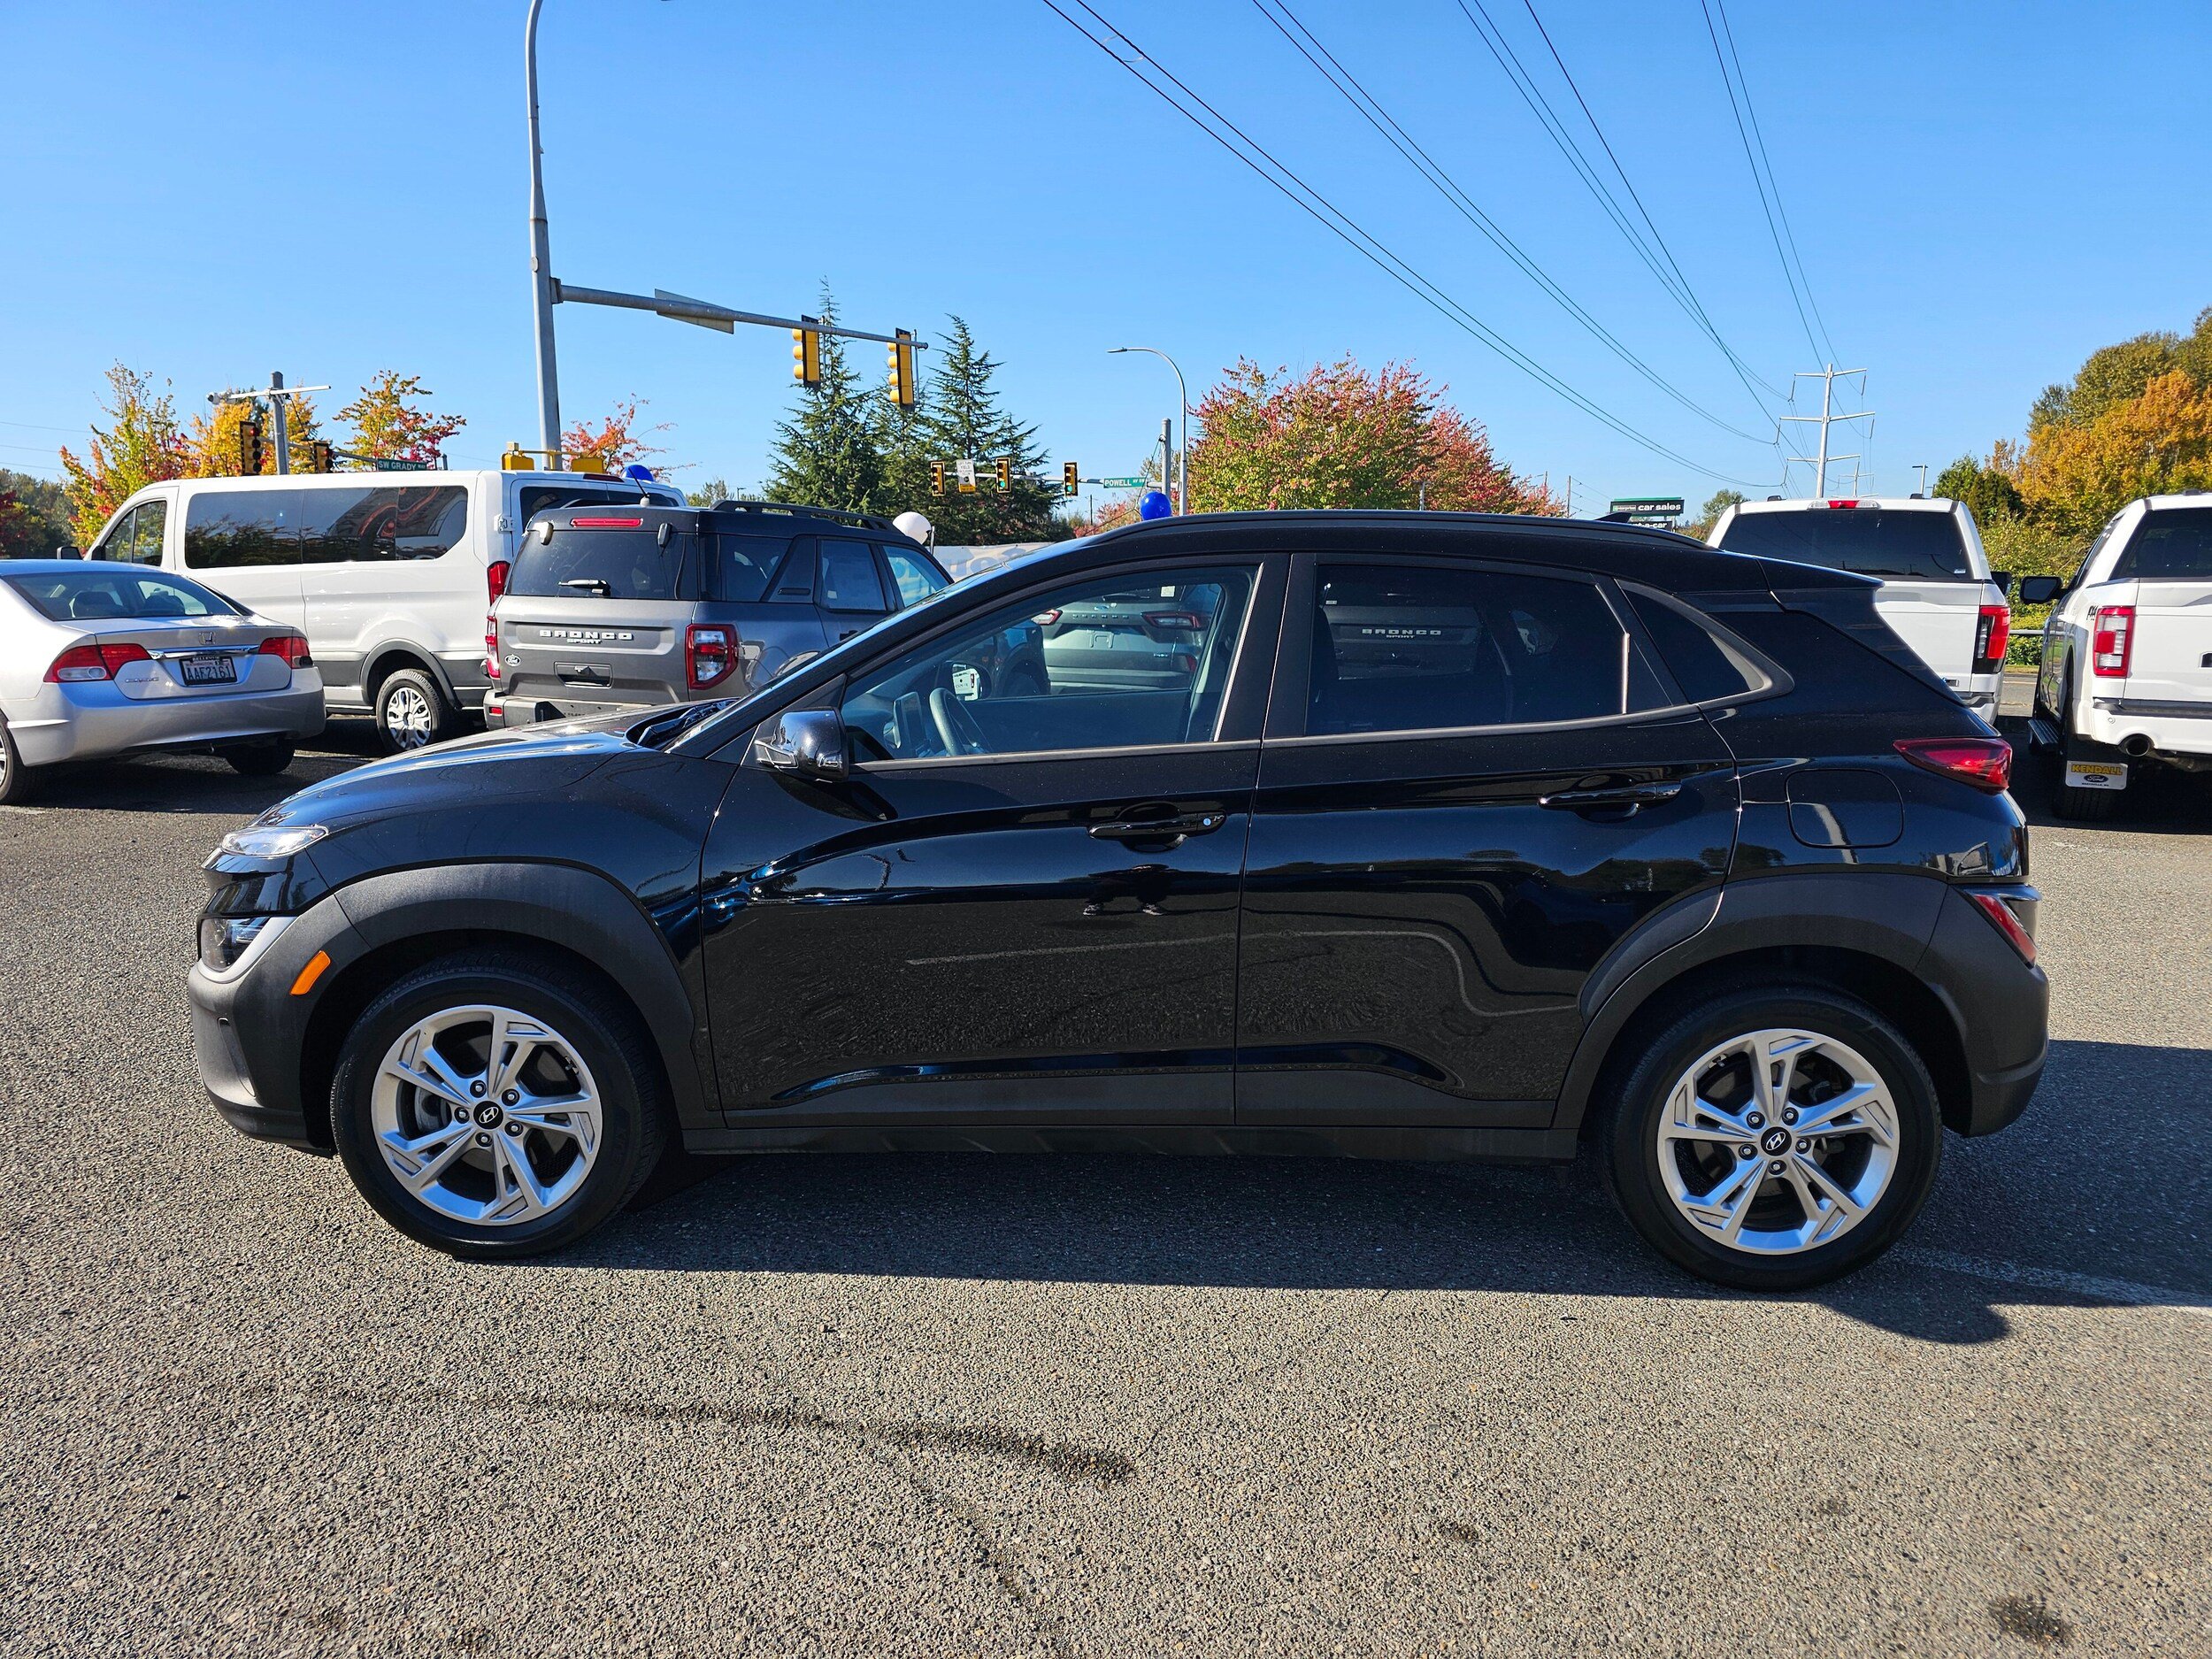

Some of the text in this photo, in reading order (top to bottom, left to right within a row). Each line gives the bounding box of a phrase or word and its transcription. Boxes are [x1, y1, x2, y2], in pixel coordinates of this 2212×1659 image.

[379, 461, 389, 469] SW
[391, 462, 416, 471] GRADY
[1655, 502, 1681, 511] sales
[539, 630, 633, 640] BRONCO
[186, 666, 231, 680] AAF2161
[2071, 764, 2123, 776] KENDALL
